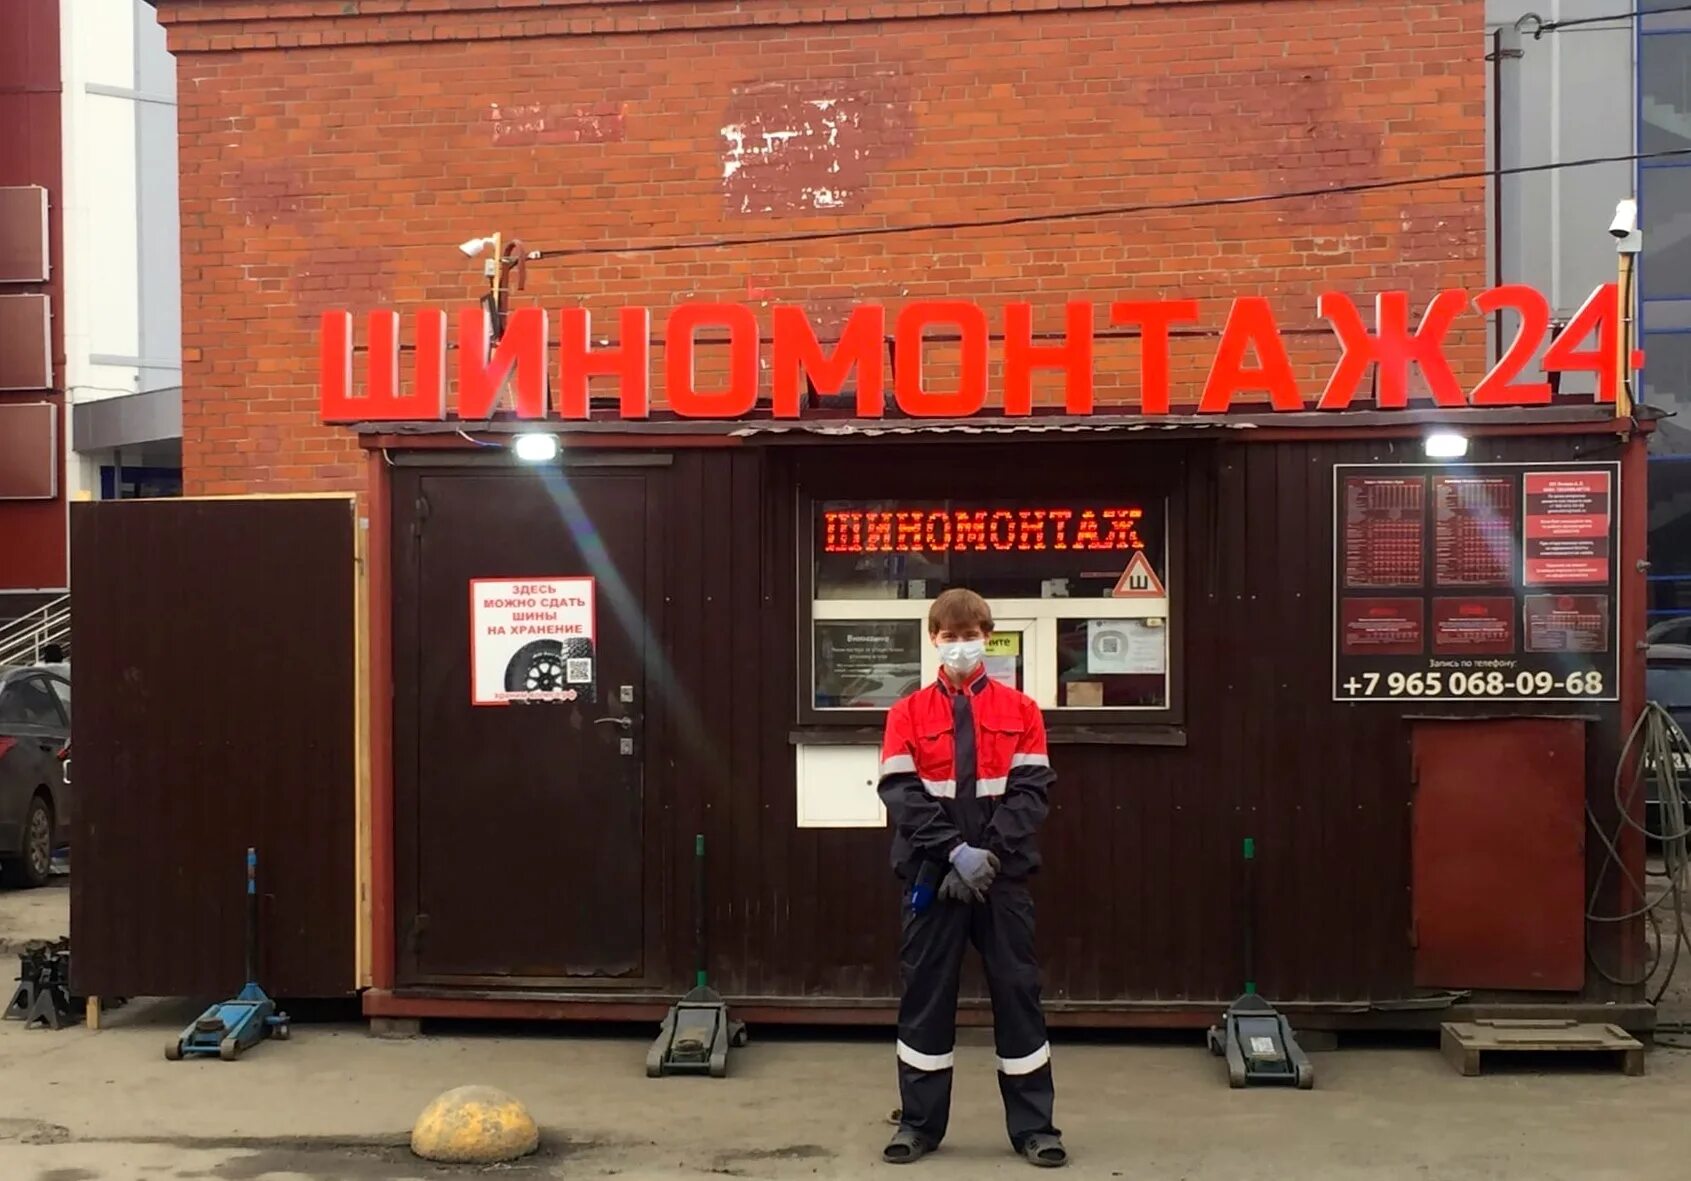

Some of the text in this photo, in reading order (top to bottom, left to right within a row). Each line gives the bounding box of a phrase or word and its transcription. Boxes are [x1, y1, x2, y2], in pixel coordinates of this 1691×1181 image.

[824, 509, 1145, 551] ШИНОМОНТАЖ
[1129, 574, 1148, 590] Ш
[512, 584, 557, 595] ЗДЕСЬ
[483, 598, 586, 608] МОЖНО СДАТЬ
[512, 611, 557, 621] ШИНЫ
[487, 624, 583, 635] НА ХРАНЕНИЕ
[1429, 659, 1460, 668] Запись
[1461, 660, 1473, 668] по
[1343, 671, 1603, 696] +7 965 068-09-68
